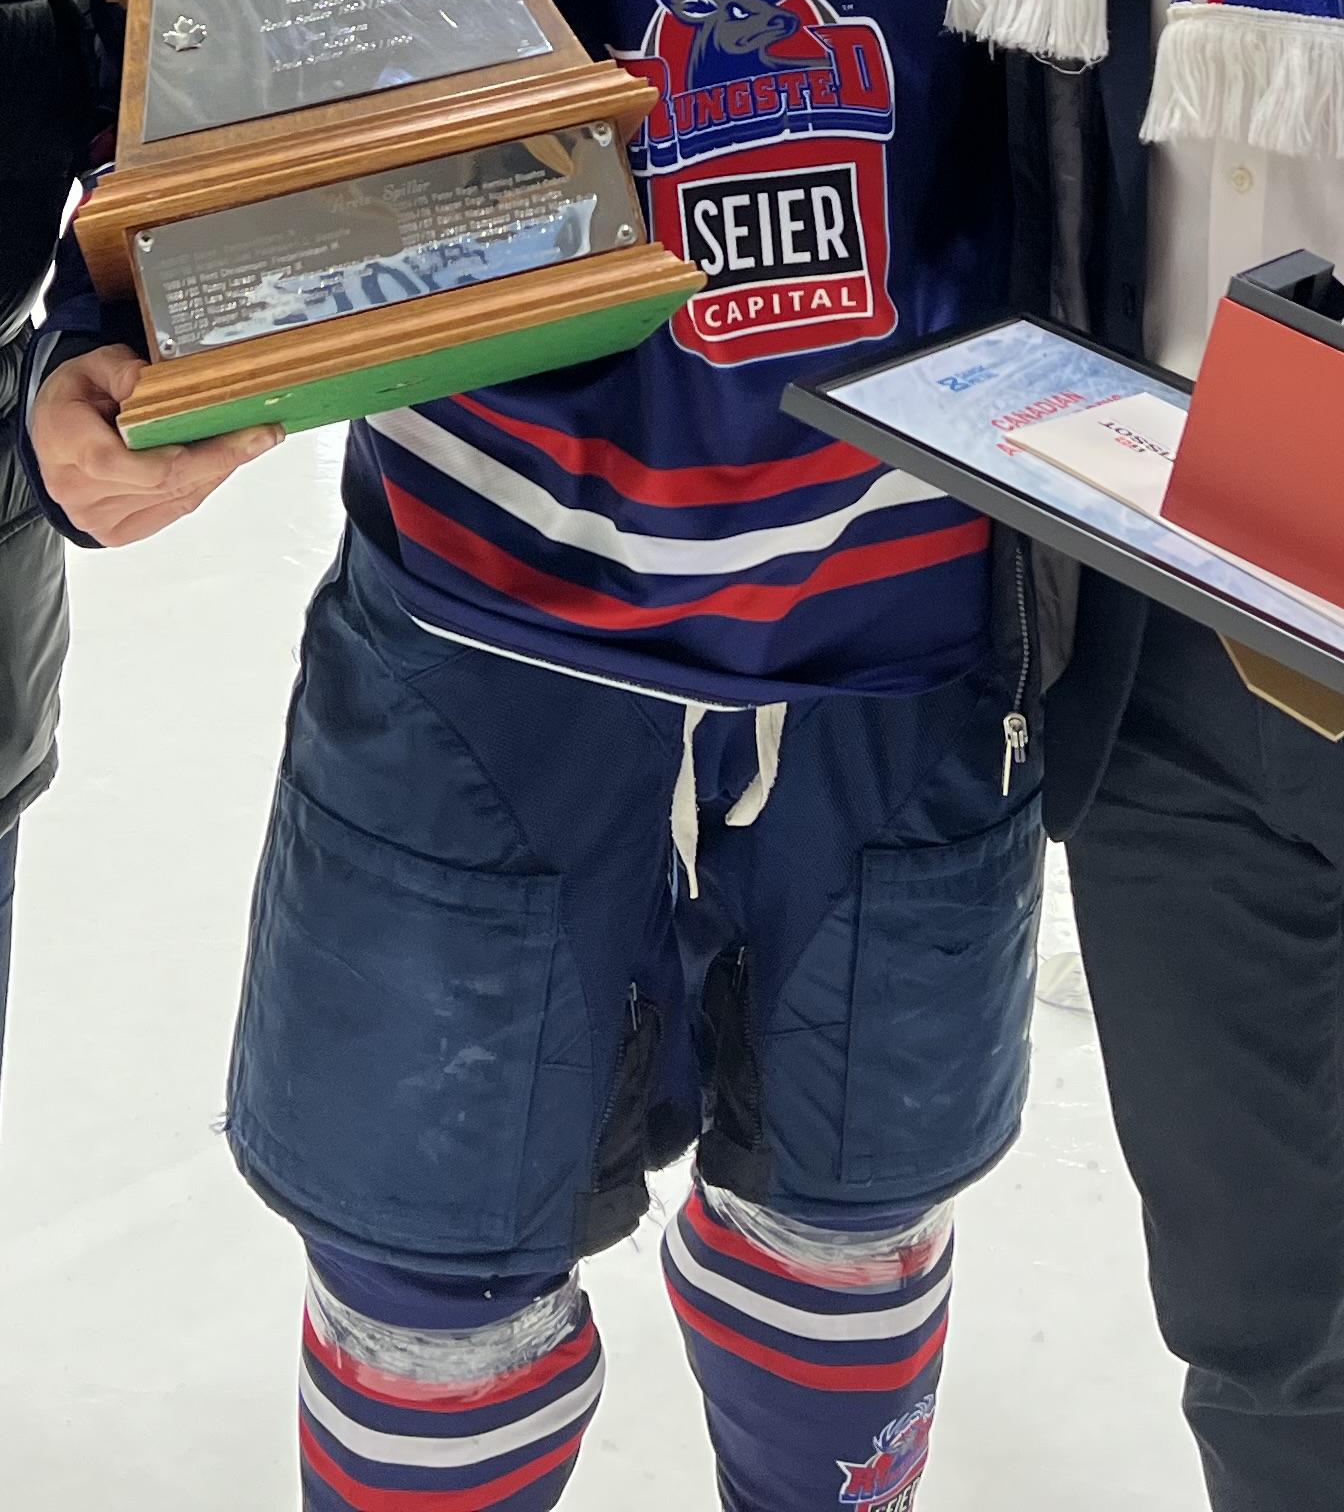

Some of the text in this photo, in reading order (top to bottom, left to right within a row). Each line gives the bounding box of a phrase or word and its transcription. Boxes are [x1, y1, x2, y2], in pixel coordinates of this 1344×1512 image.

[693, 186, 849, 276] SEIER
[705, 286, 857, 328] CAPITAL
[991, 390, 1088, 432] CANADIAN
